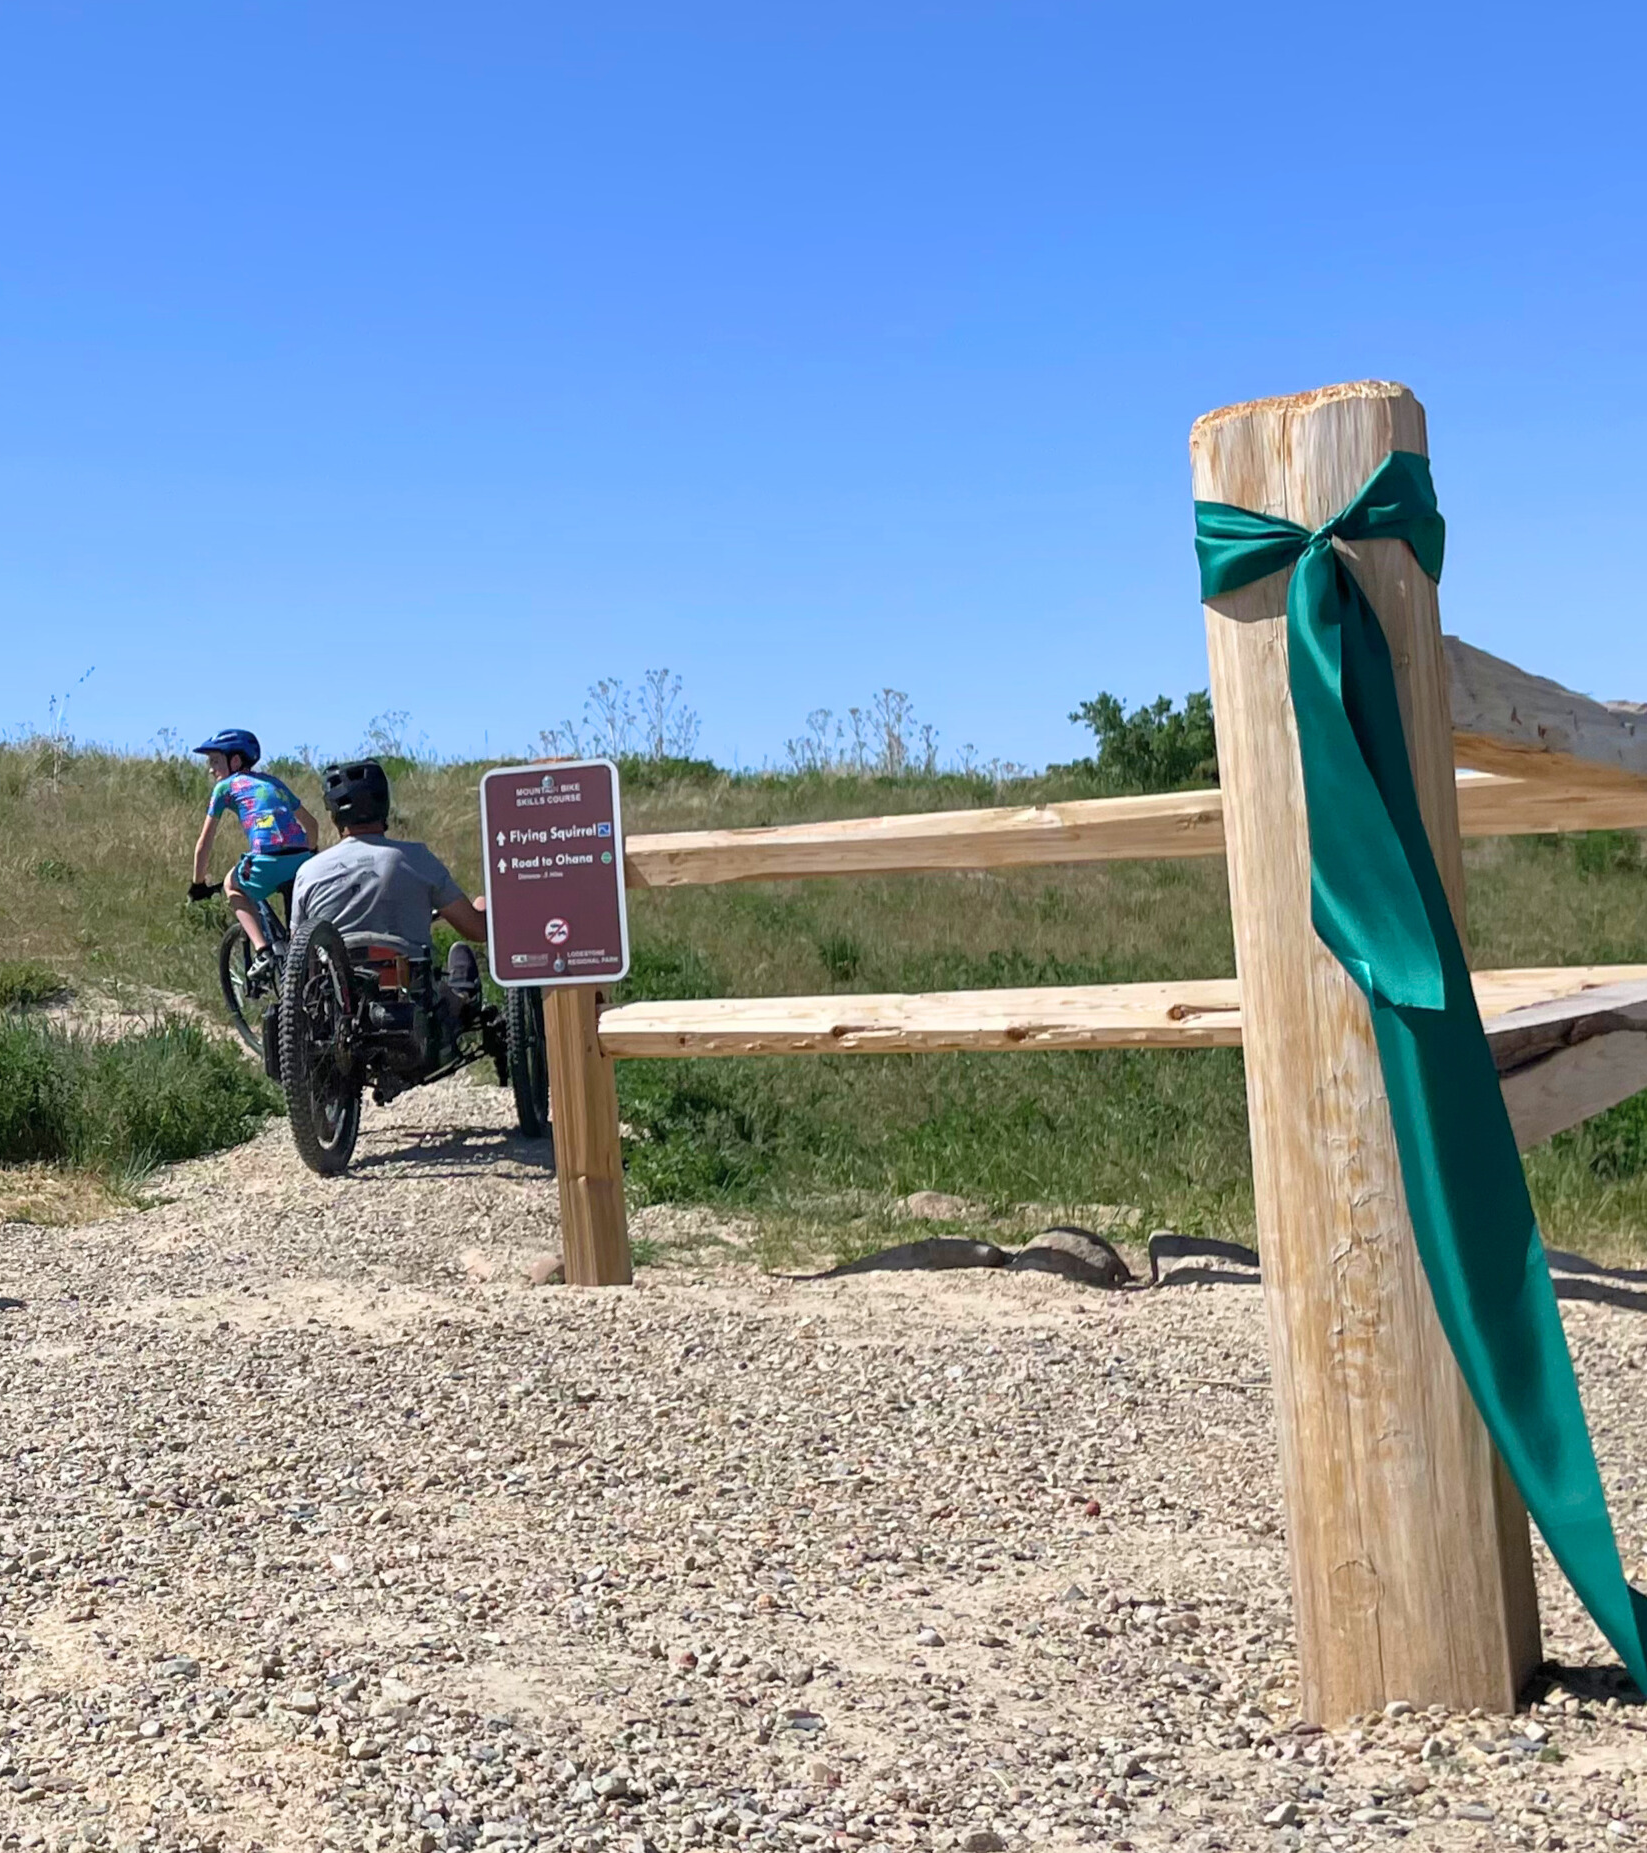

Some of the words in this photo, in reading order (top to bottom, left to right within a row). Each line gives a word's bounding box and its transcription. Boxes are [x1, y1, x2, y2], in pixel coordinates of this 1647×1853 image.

[560, 783, 580, 793] BIKE
[516, 796, 545, 807] SKILLS
[546, 793, 581, 804] COURSE
[509, 828, 547, 845] Flying
[550, 823, 596, 841] Squirrel
[511, 855, 539, 869] Road
[542, 856, 553, 867] to
[555, 853, 593, 865] Ohana
